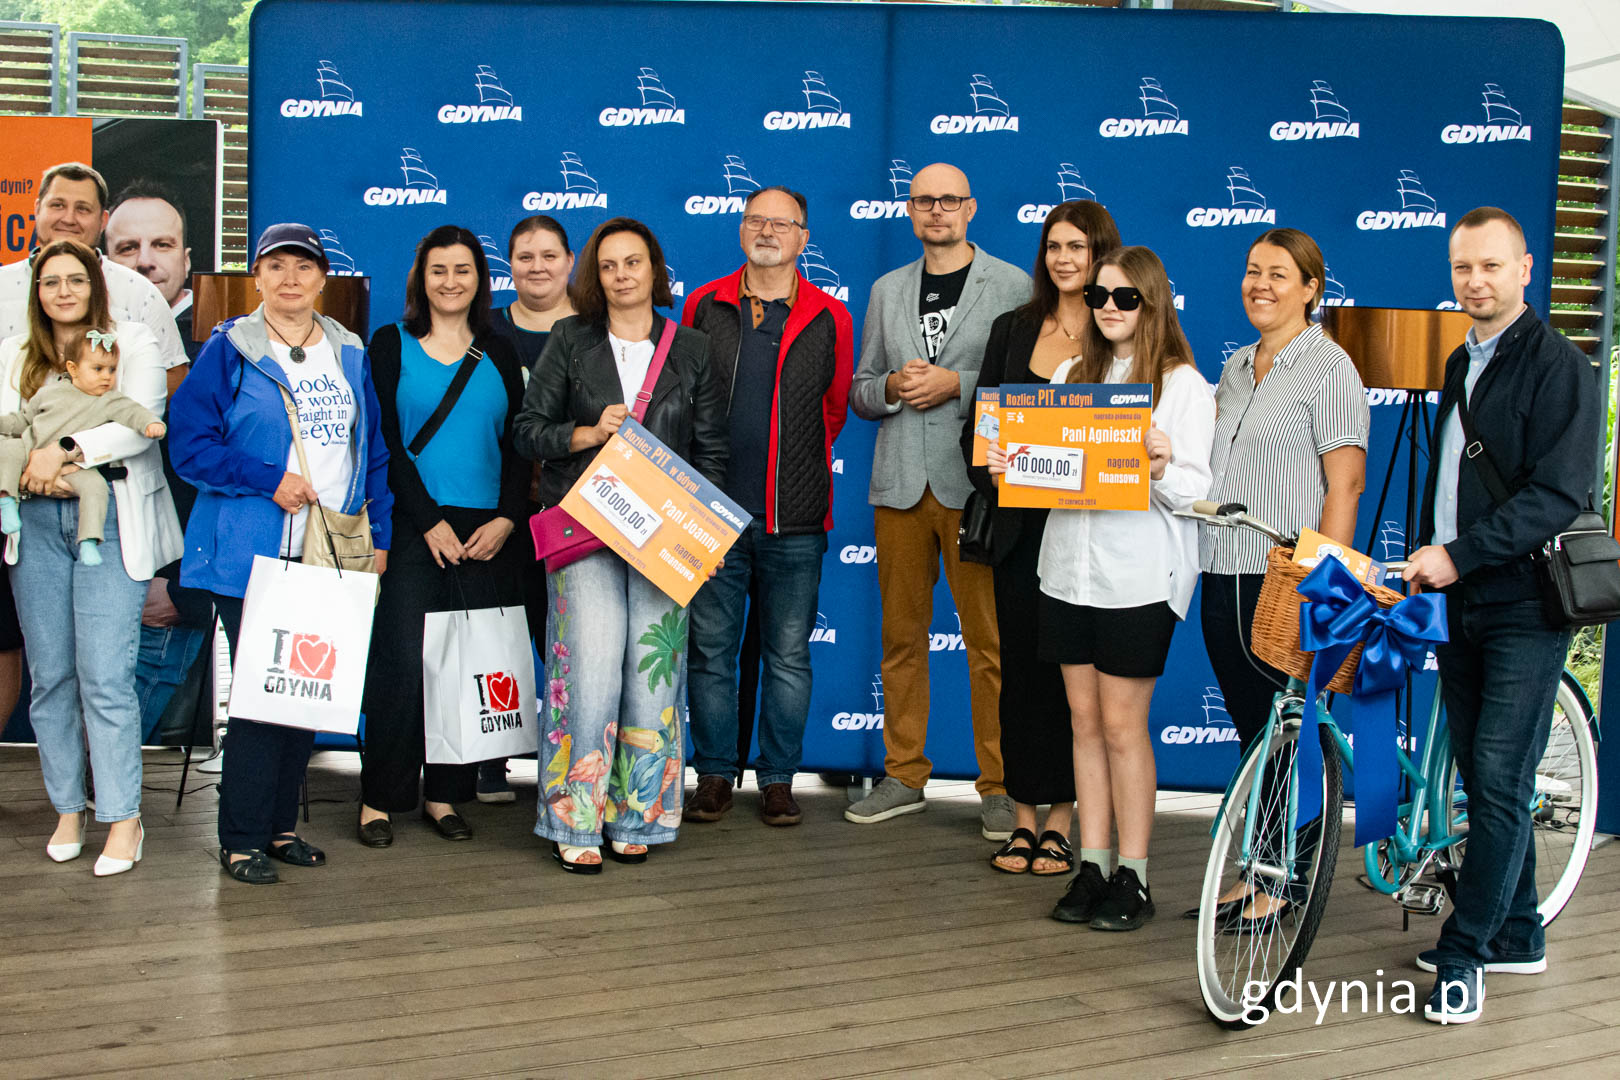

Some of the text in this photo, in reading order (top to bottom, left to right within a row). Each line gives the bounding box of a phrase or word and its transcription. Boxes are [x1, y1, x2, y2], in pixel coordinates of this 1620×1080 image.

[280, 99, 363, 118] GDYNIA
[438, 104, 522, 124] GDYNIA
[599, 107, 685, 127] GDYNIA
[763, 111, 850, 131] GDYNIA
[930, 114, 1019, 135] GDYNIA
[1099, 118, 1189, 138] GDYNIA
[1269, 121, 1360, 141] GDYNIA
[1441, 124, 1531, 144] GDYNIA
[0, 179, 33, 195] dyni?
[363, 187, 447, 206] GDYNIA
[522, 191, 608, 211] GDYNIA
[685, 195, 746, 215] GDYN
[850, 200, 909, 220] GDYN
[1186, 207, 1276, 227] GDYNIA
[1356, 210, 1447, 231] GDYNIA
[294, 374, 340, 393] ook
[308, 390, 352, 408] world
[1006, 393, 1036, 406] Rozlicz
[1060, 397, 1067, 406] w
[1069, 393, 1093, 408] Gdyni
[1110, 394, 1149, 405] GDYNIA
[337, 406, 347, 420] in
[310, 422, 349, 447] eye.
[1062, 426, 1142, 444] Pani Agnieszki
[623, 427, 653, 455] Rozlicz
[675, 470, 702, 495] Gdyni
[1017, 456, 1028, 472] 10
[1031, 457, 1070, 477] 000,00
[1107, 457, 1140, 469] nagroda
[1098, 471, 1140, 484] finansowa
[608, 488, 646, 530] 000,00
[709, 500, 745, 530] GDYNIA
[661, 498, 687, 526] Pani
[682, 517, 722, 554] Joanny
[659, 547, 696, 582] finansowa
[674, 543, 704, 571] nagroda
[266, 628, 290, 674] I
[264, 675, 332, 702] GDYNIA
[473, 674, 489, 715] I
[481, 711, 523, 734] GDYNIA
